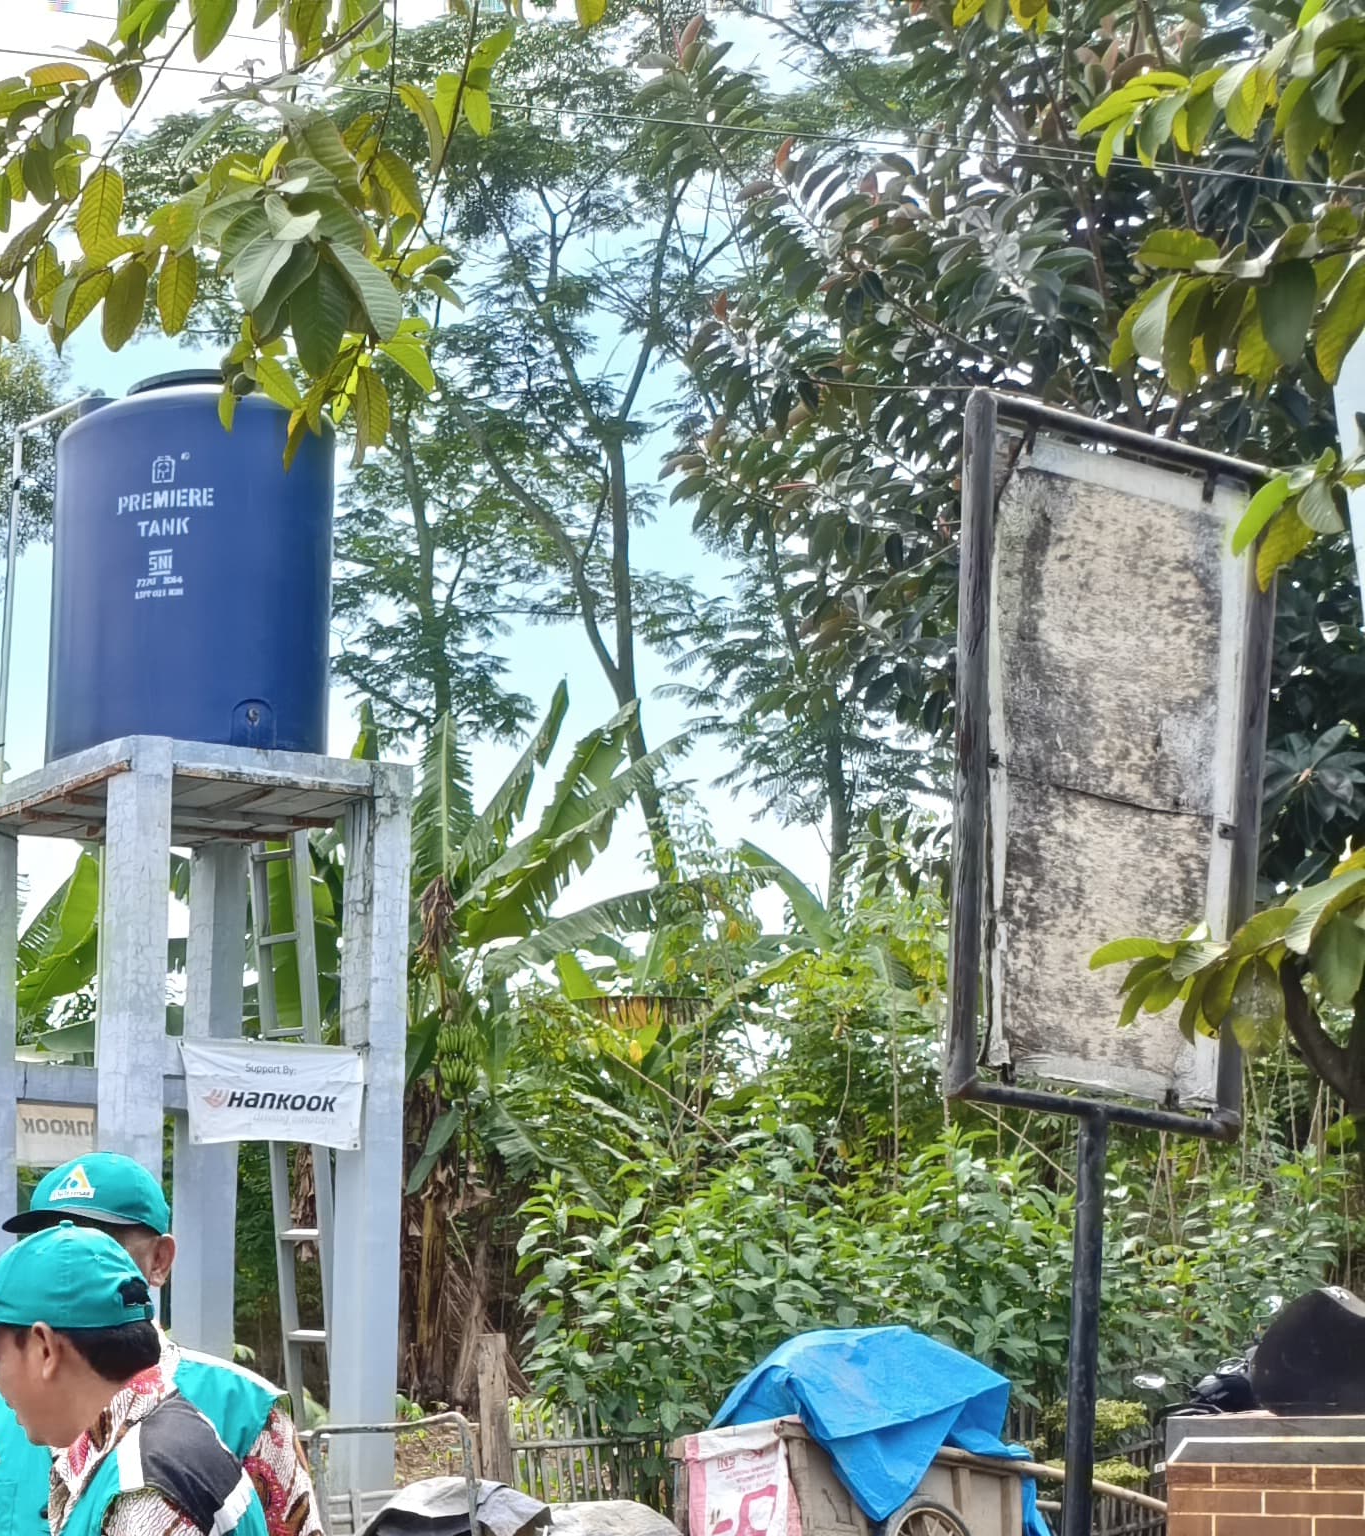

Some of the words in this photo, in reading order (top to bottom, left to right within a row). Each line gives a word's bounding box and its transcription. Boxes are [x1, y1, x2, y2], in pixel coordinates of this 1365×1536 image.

[117, 487, 214, 516] PREMIERE
[137, 516, 190, 538] TANK
[148, 554, 173, 572] SNI
[245, 1063, 281, 1075] Support
